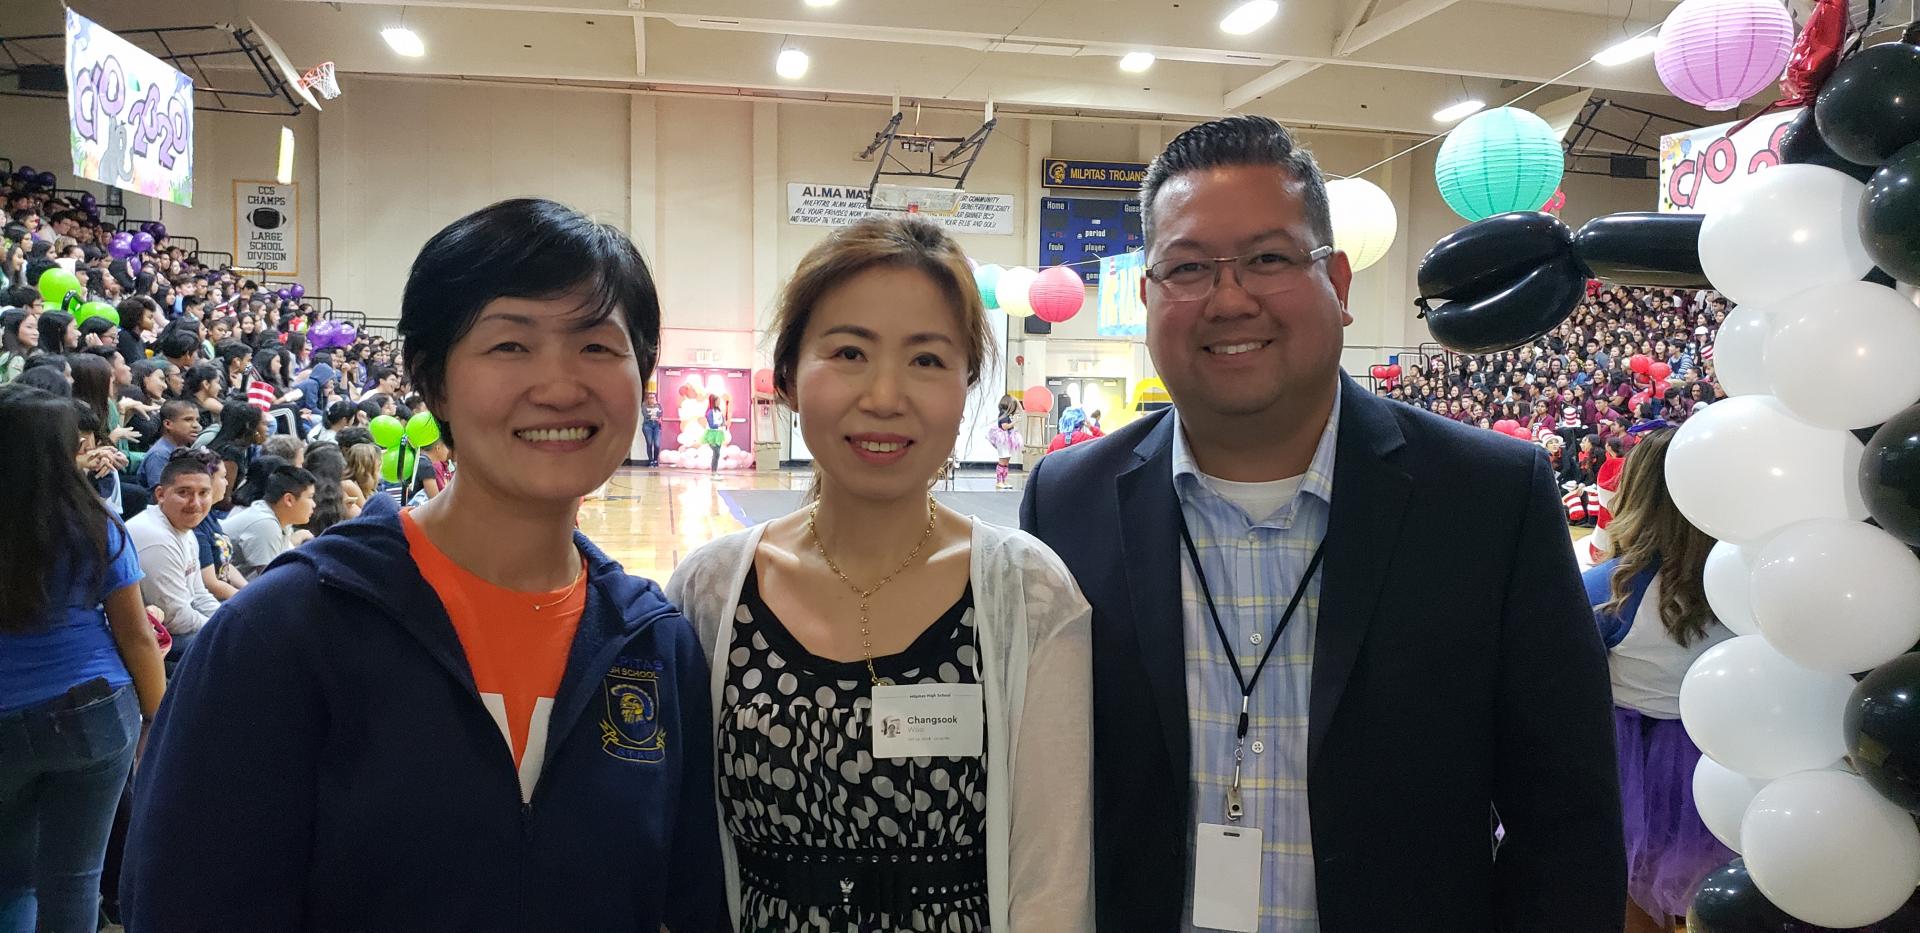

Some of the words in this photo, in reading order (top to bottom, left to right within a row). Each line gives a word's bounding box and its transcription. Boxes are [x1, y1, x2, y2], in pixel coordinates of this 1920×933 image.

[128, 82, 188, 171] 2020
[1070, 168, 1105, 180] MILPITAS
[1109, 170, 1147, 182] TROJANS
[258, 186, 275, 195] CCS
[802, 186, 842, 198] ALMA
[247, 195, 286, 206] CHAMPS
[969, 195, 1001, 203] COMMUNITY
[1047, 201, 1065, 210] Home
[795, 207, 806, 215] ALL
[251, 231, 283, 241] LARGE
[1085, 230, 1106, 238] period
[250, 241, 284, 251] SCHOOL
[1084, 243, 1106, 253] player
[247, 251, 287, 261] DIVISION
[256, 262, 278, 271] 2006
[621, 667, 660, 679] SCHOOL
[907, 715, 958, 726] Changsook
